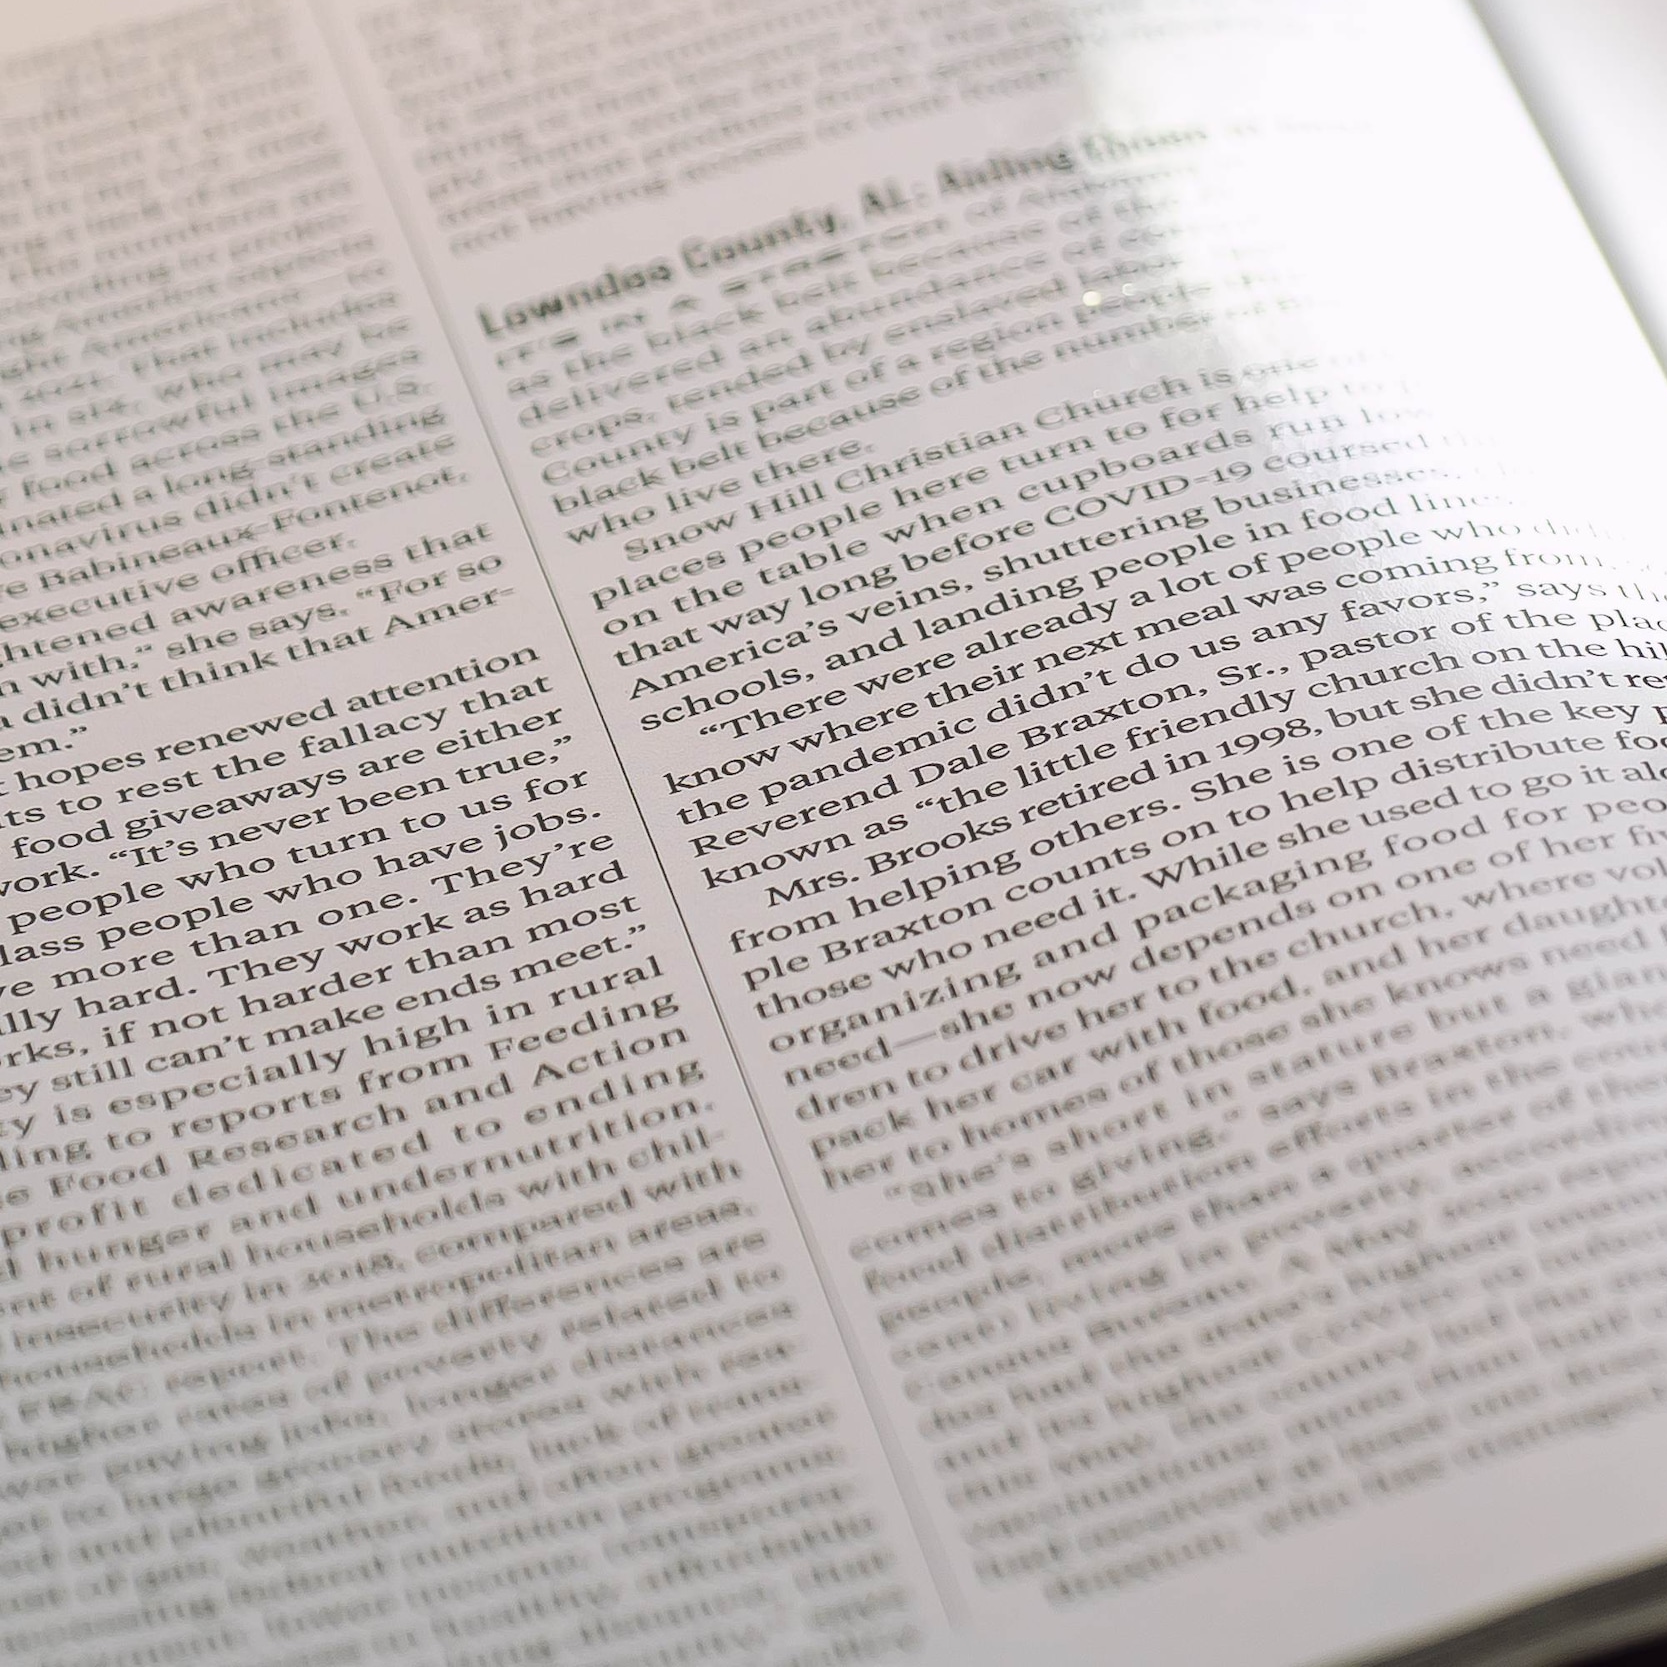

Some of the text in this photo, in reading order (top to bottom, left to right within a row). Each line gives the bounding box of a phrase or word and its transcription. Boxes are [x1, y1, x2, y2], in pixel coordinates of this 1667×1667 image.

[10, 707, 563, 860] food giveaways are either
[56, 676, 553, 816] to rest the fallacy that
[108, 734, 572, 868] “It’s never been true,”
[688, 773, 904, 859] Reverend
[909, 742, 1010, 788] Dale
[1016, 683, 1208, 750] Braxton,
[1216, 662, 1290, 687] Sr.,
[1298, 625, 1437, 672] pastor
[1450, 611, 1494, 636] of
[1503, 609, 1577, 630] the
[701, 832, 856, 890] known
[863, 813, 909, 840] as
[915, 780, 1009, 814] “the
[1013, 742, 1117, 789] little
[1125, 688, 1296, 752] friendly
[1307, 651, 1464, 698] church
[1471, 646, 1530, 666] on
[1534, 638, 1608, 659] the
[764, 870, 860, 908] Mrs.
[864, 815, 1012, 877] Brooks
[1018, 758, 1160, 826] retired
[1164, 750, 1211, 775] in
[1216, 717, 1323, 759] 1998,
[1324, 698, 1405, 728] but
[1409, 685, 1483, 711] she
[1491, 668, 1619, 696] didn’t
[7, 770, 588, 935] people who turn to us for
[96, 807, 601, 951] people who have jobs.
[730, 910, 840, 954] from
[847, 849, 1022, 918] helping
[1029, 798, 1181, 857] others.
[1190, 767, 1273, 803] She
[1282, 754, 1321, 776] is
[1331, 733, 1414, 763] one
[1425, 713, 1470, 742] of
[1478, 706, 1553, 731] the
[1560, 700, 1640, 725] key
[50, 834, 615, 989] more than one. They’re
[74, 858, 629, 1019] hard. They work as hard
[101, 896, 641, 1048] if not harder than most
